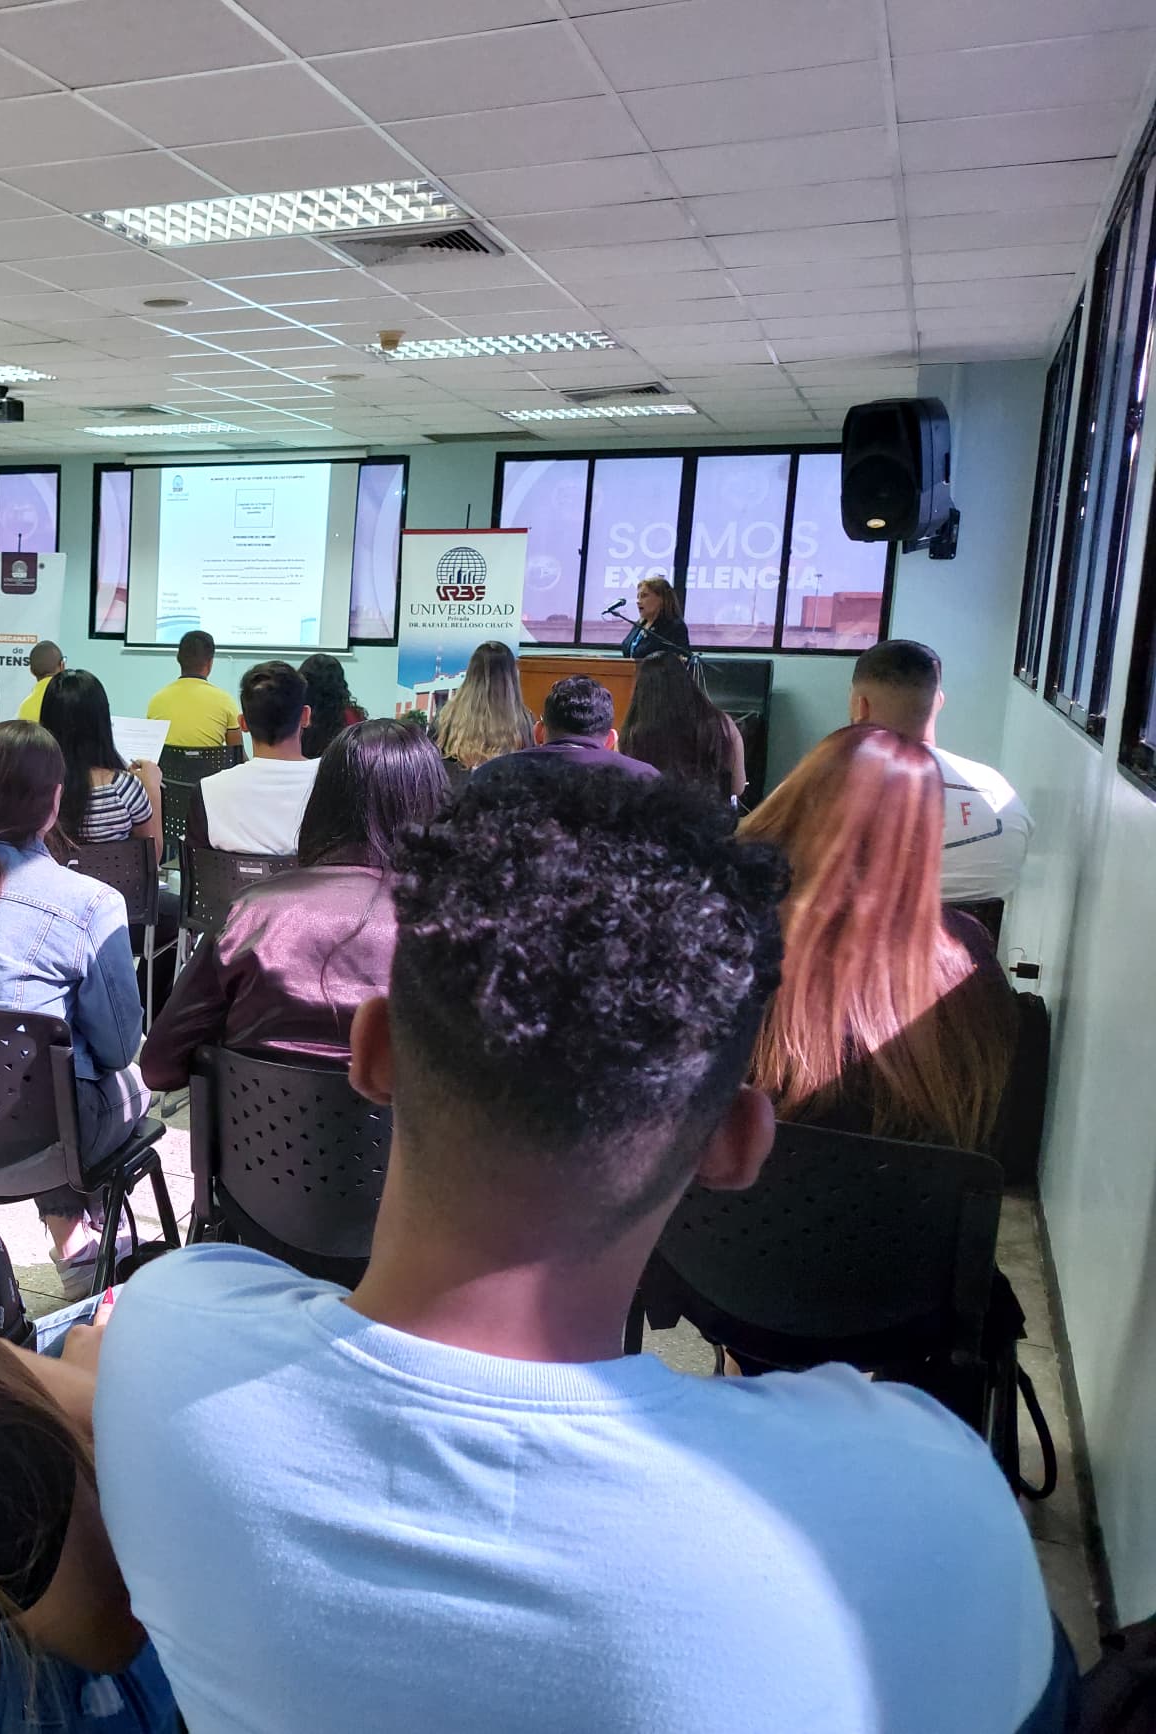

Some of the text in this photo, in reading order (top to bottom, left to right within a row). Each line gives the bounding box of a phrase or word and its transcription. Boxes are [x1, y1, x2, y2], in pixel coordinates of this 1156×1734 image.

[607, 521, 820, 559] SOMOS
[410, 603, 515, 616] UNIVERSIDAD
[12, 647, 24, 655] de
[960, 802, 971, 825] F
